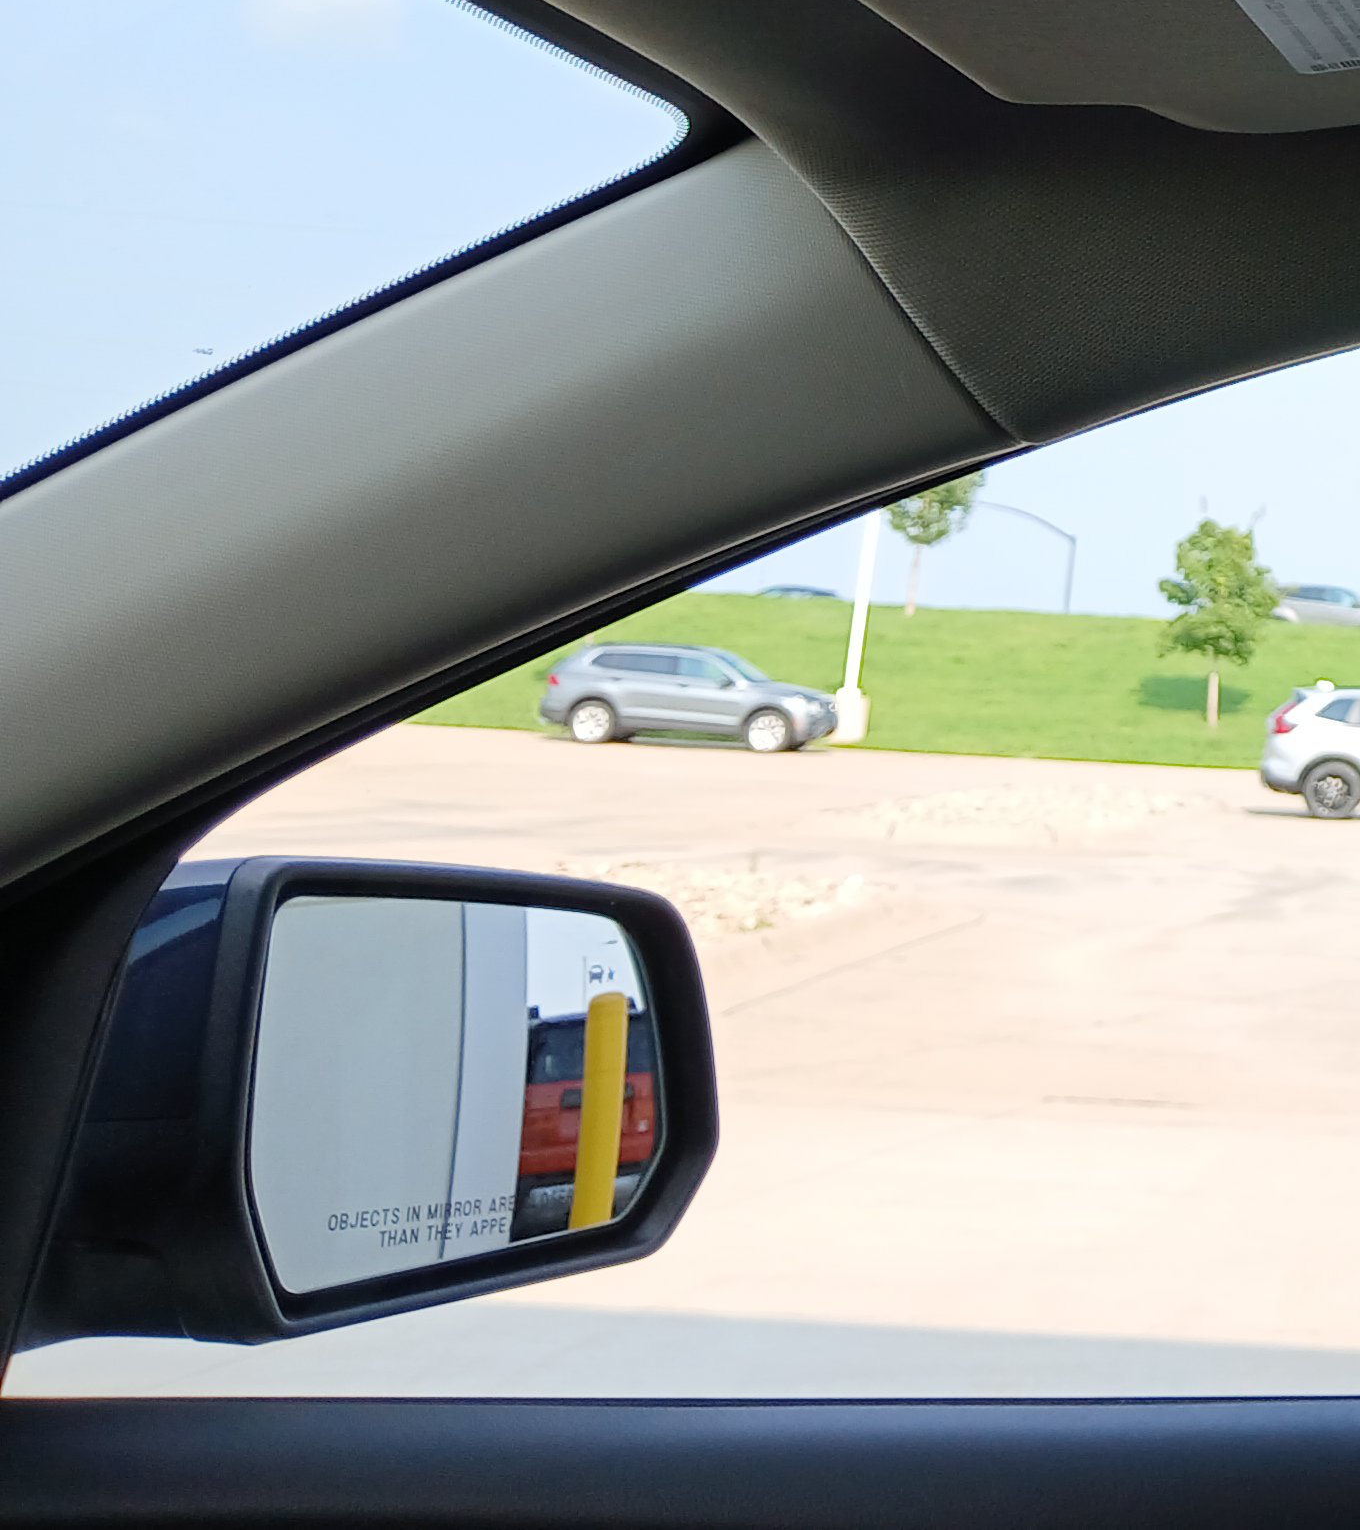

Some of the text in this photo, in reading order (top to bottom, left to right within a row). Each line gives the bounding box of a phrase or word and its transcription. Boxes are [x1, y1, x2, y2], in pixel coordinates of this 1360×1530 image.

[327, 1207, 400, 1232] OBJECTS
[406, 1204, 421, 1223] IN
[426, 1199, 482, 1221] MIRROR
[487, 1194, 516, 1213] ARE
[380, 1228, 420, 1248] THAN
[426, 1222, 464, 1242] THEY
